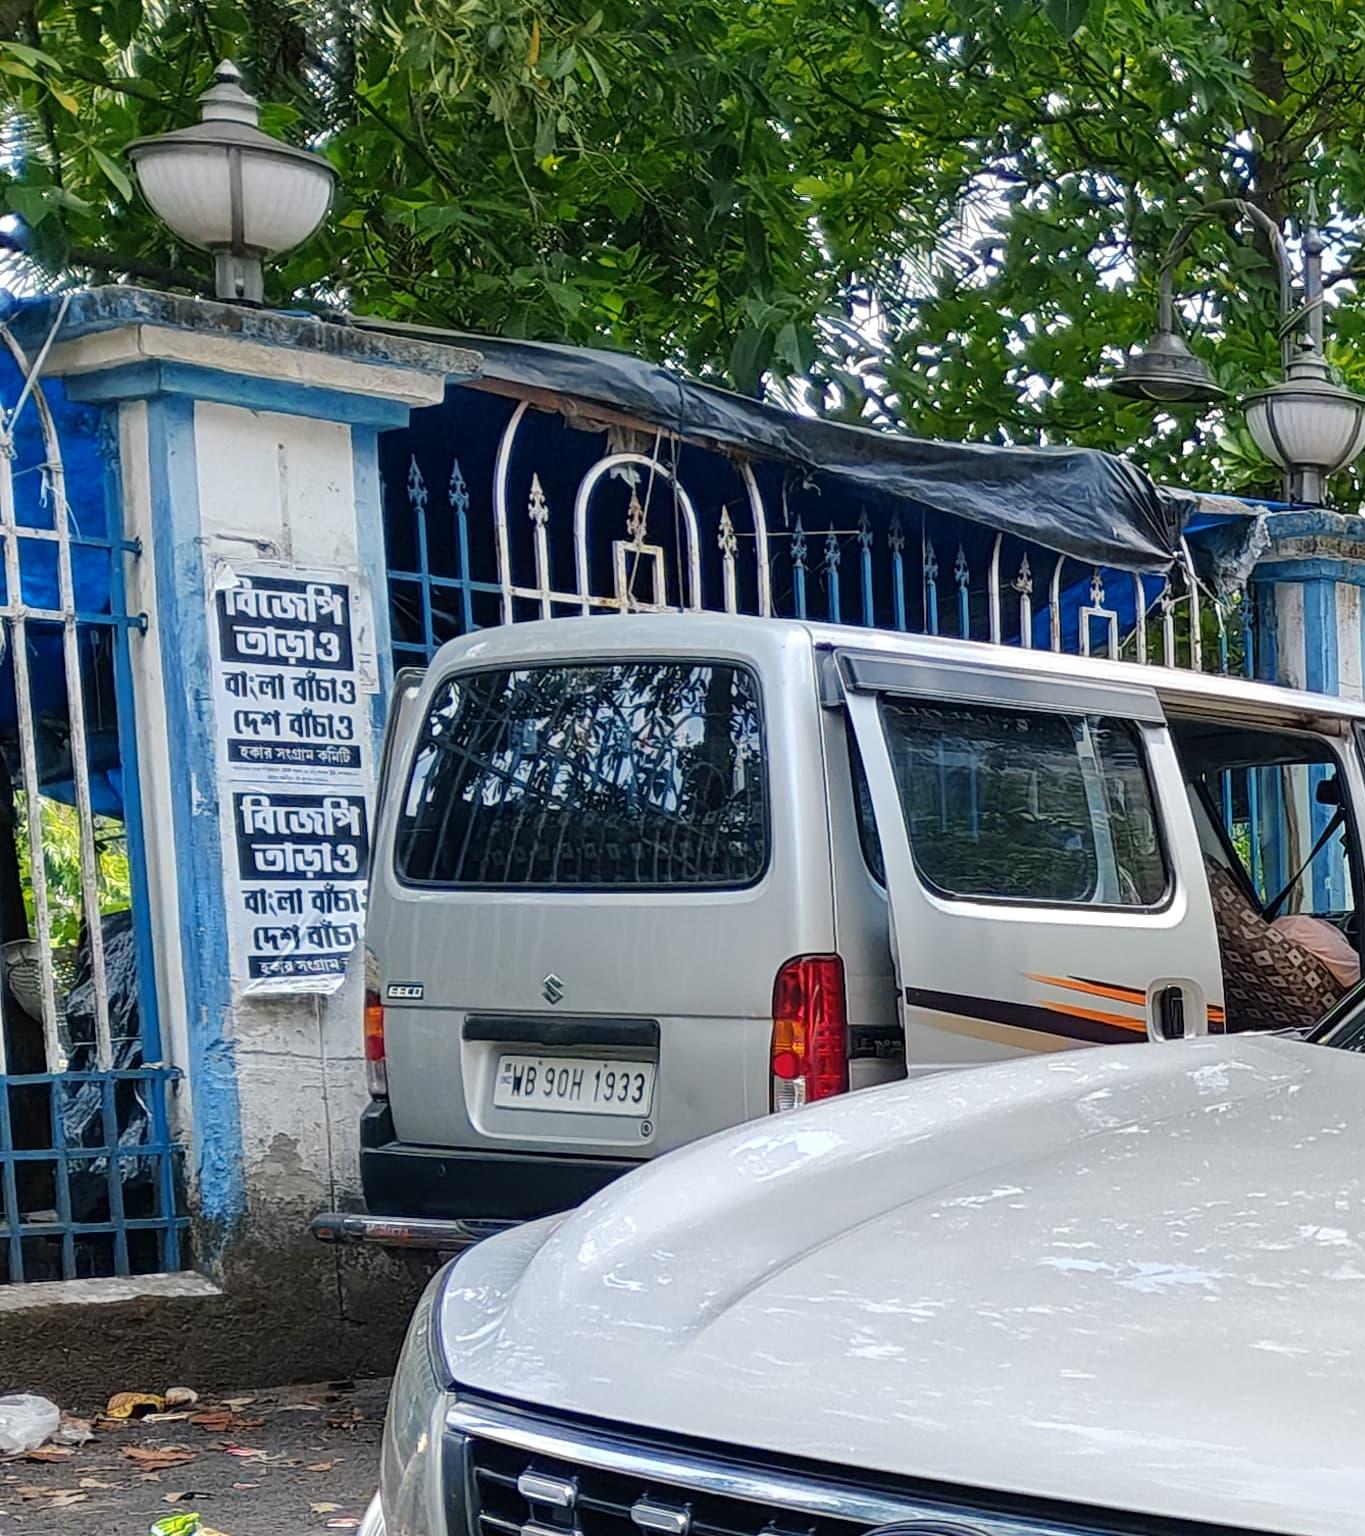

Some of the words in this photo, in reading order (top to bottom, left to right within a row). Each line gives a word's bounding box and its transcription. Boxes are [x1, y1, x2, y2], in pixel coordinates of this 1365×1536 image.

[224, 577, 344, 625] বিজেপি
[232, 625, 340, 665] তাড়াও
[222, 671, 285, 700] বাংলা
[290, 670, 356, 704] বাঁচাও
[234, 709, 281, 736] দেশ
[286, 707, 354, 740] বাঁচাও
[239, 745, 273, 760] হকার
[276, 746, 314, 761] সংগ্রাম
[317, 747, 352, 764] কমিটি
[240, 795, 361, 836] বিজেপি
[251, 841, 358, 878] তাড়াও
[241, 888, 303, 916] বাংলা
[254, 924, 301, 950] দেশ
[306, 919, 360, 949] বাঁচা
[389, 986, 423, 997] EECO
[511, 1064, 537, 1096] WB
[543, 1067, 585, 1101] 90H
[594, 1069, 646, 1103] 1933
